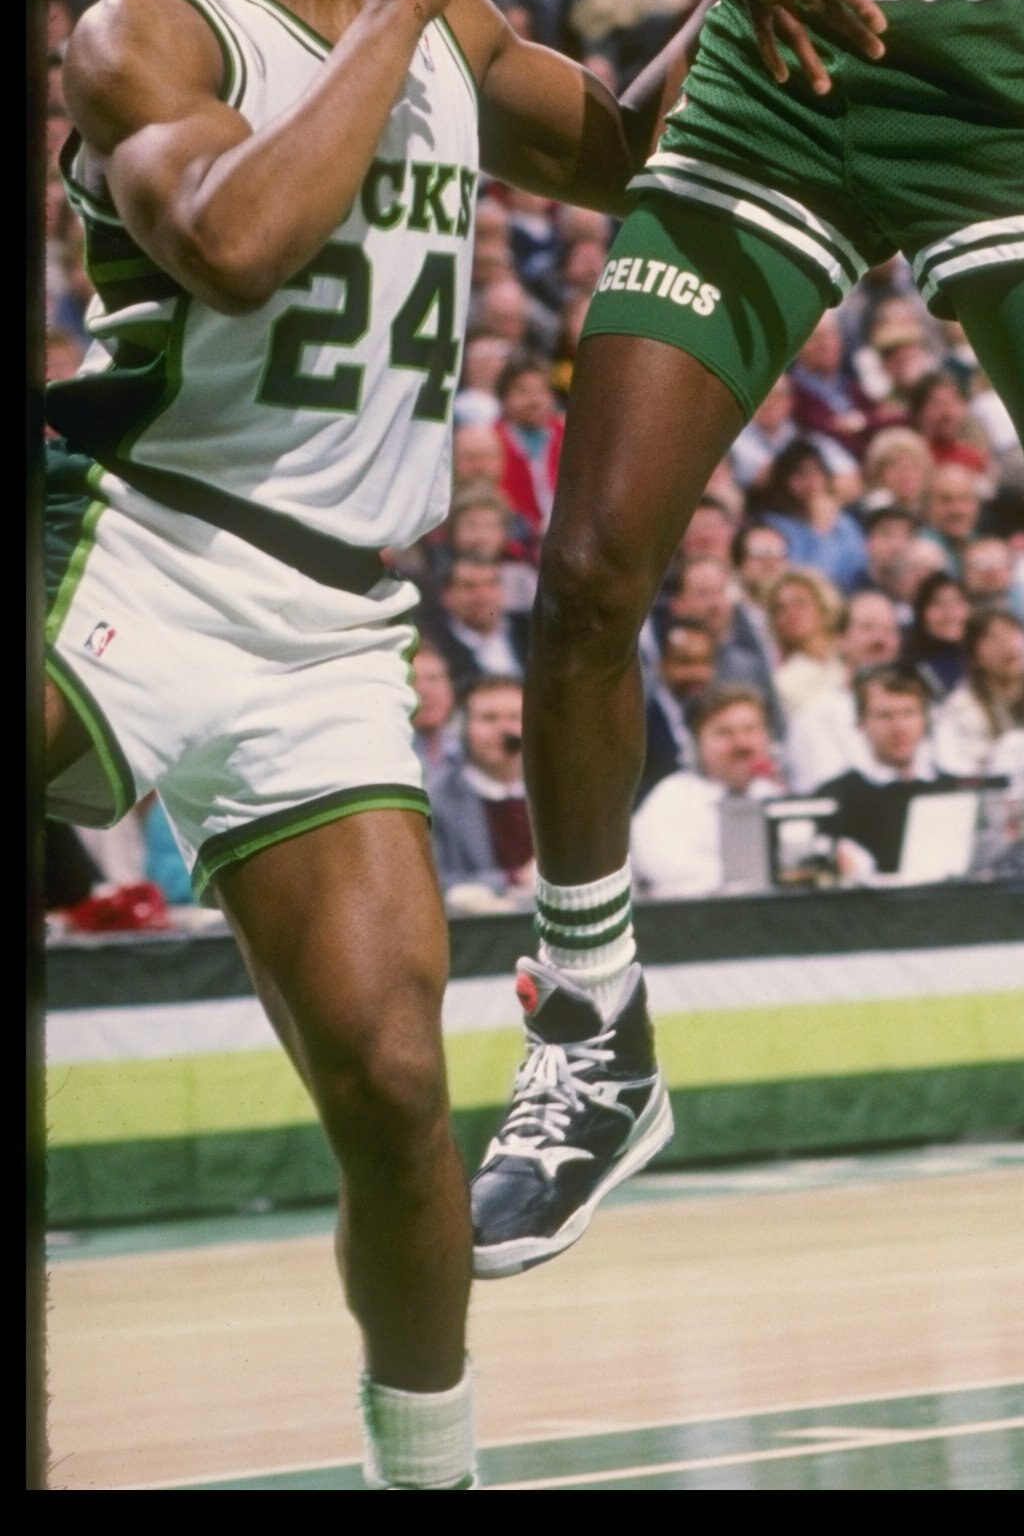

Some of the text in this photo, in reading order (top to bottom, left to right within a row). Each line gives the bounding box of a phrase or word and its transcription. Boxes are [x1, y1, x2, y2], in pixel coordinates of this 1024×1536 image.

[361, 157, 477, 239] CKS
[598, 257, 721, 316] CELTICS
[255, 241, 460, 424] 24
